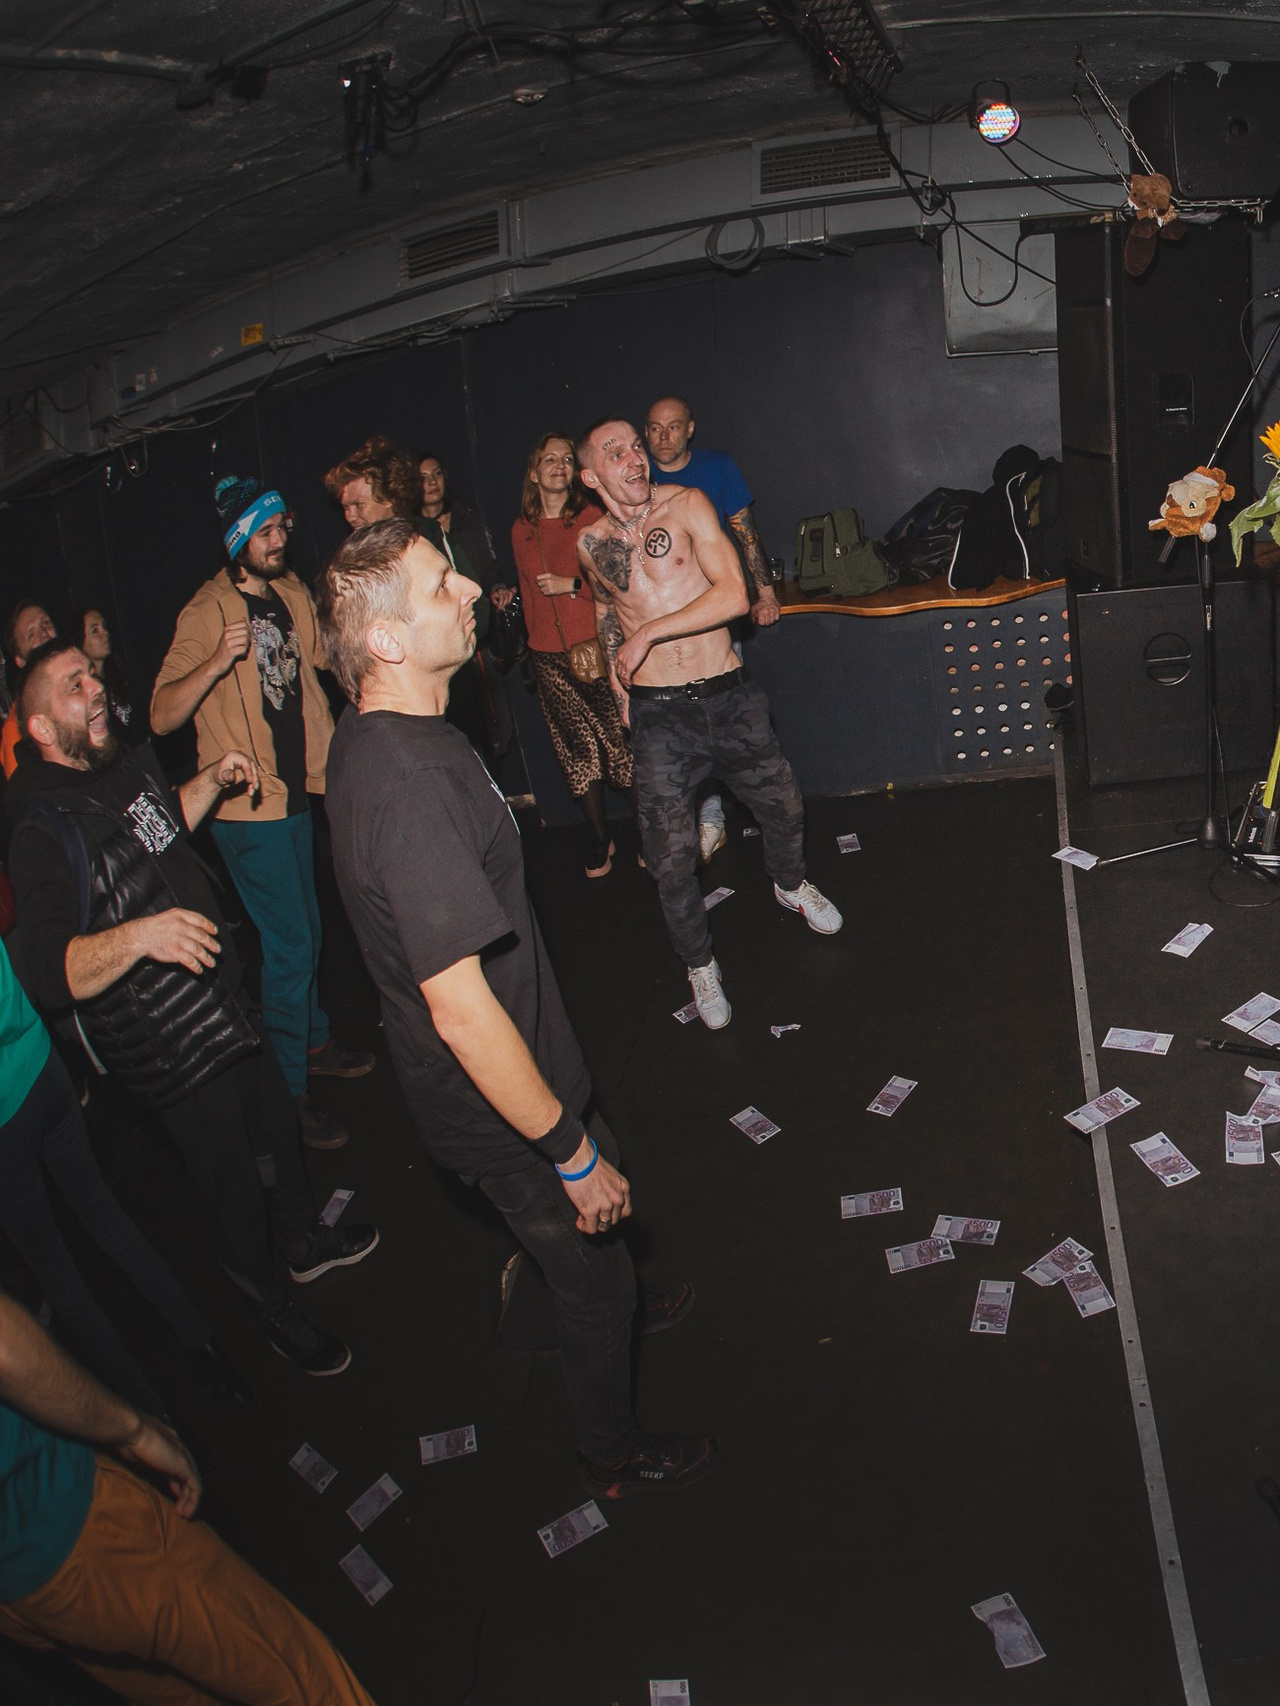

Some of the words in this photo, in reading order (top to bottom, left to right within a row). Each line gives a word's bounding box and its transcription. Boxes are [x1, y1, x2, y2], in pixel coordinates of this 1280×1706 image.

[1098, 1091, 1120, 1106] 500
[876, 1189, 896, 1198] 500
[970, 1220, 994, 1229] 500
[922, 1238, 944, 1249] 500
